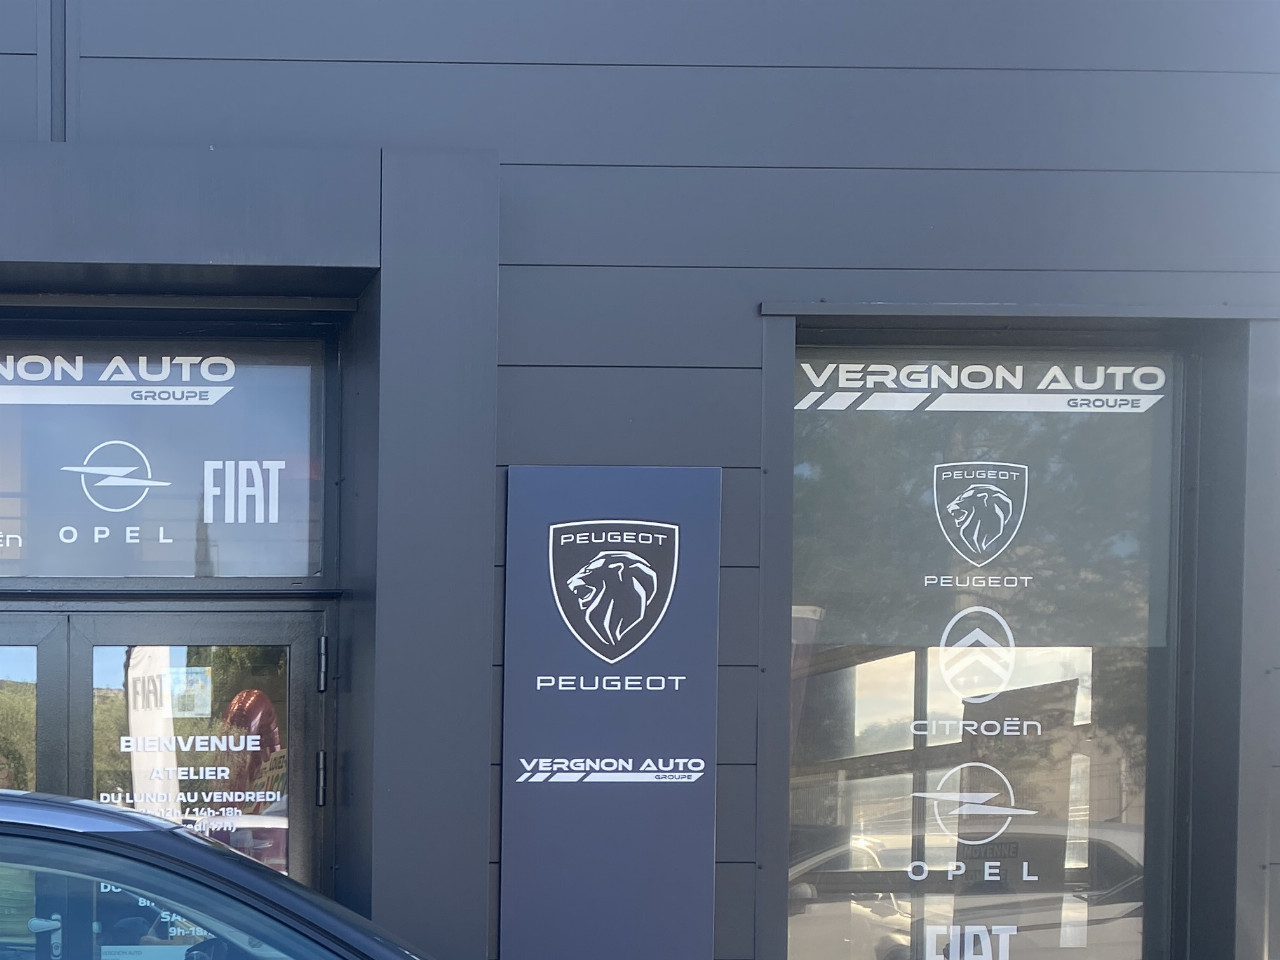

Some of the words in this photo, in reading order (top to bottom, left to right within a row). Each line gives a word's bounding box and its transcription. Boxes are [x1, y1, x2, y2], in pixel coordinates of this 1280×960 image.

[98, 356, 236, 383] AUTO
[801, 363, 1024, 390] VERGNON
[1037, 365, 1166, 391] AUTO
[130, 390, 210, 401] GROUPE
[1067, 398, 1141, 409] GROUPE
[941, 470, 1021, 481] PEUGEOT
[203, 460, 286, 524] FIAT
[59, 526, 173, 544] OPEL
[560, 531, 668, 546] PEUGEOT
[924, 576, 1034, 588] PEUGEOT
[536, 676, 687, 691] PEUGEOT
[131, 673, 166, 712] FIAT
[120, 735, 261, 752] BIENVENUE
[520, 758, 634, 771] VERGNON
[639, 758, 706, 772] AUTO
[150, 767, 230, 780] ATELIER
[100, 792, 121, 804] DU
[125, 792, 171, 803] LUNDI
[176, 792, 198, 803] AU
[201, 791, 281, 803] VENDREDI
[192, 807, 243, 818] 14h-18h
[907, 861, 1039, 881] OPEL
